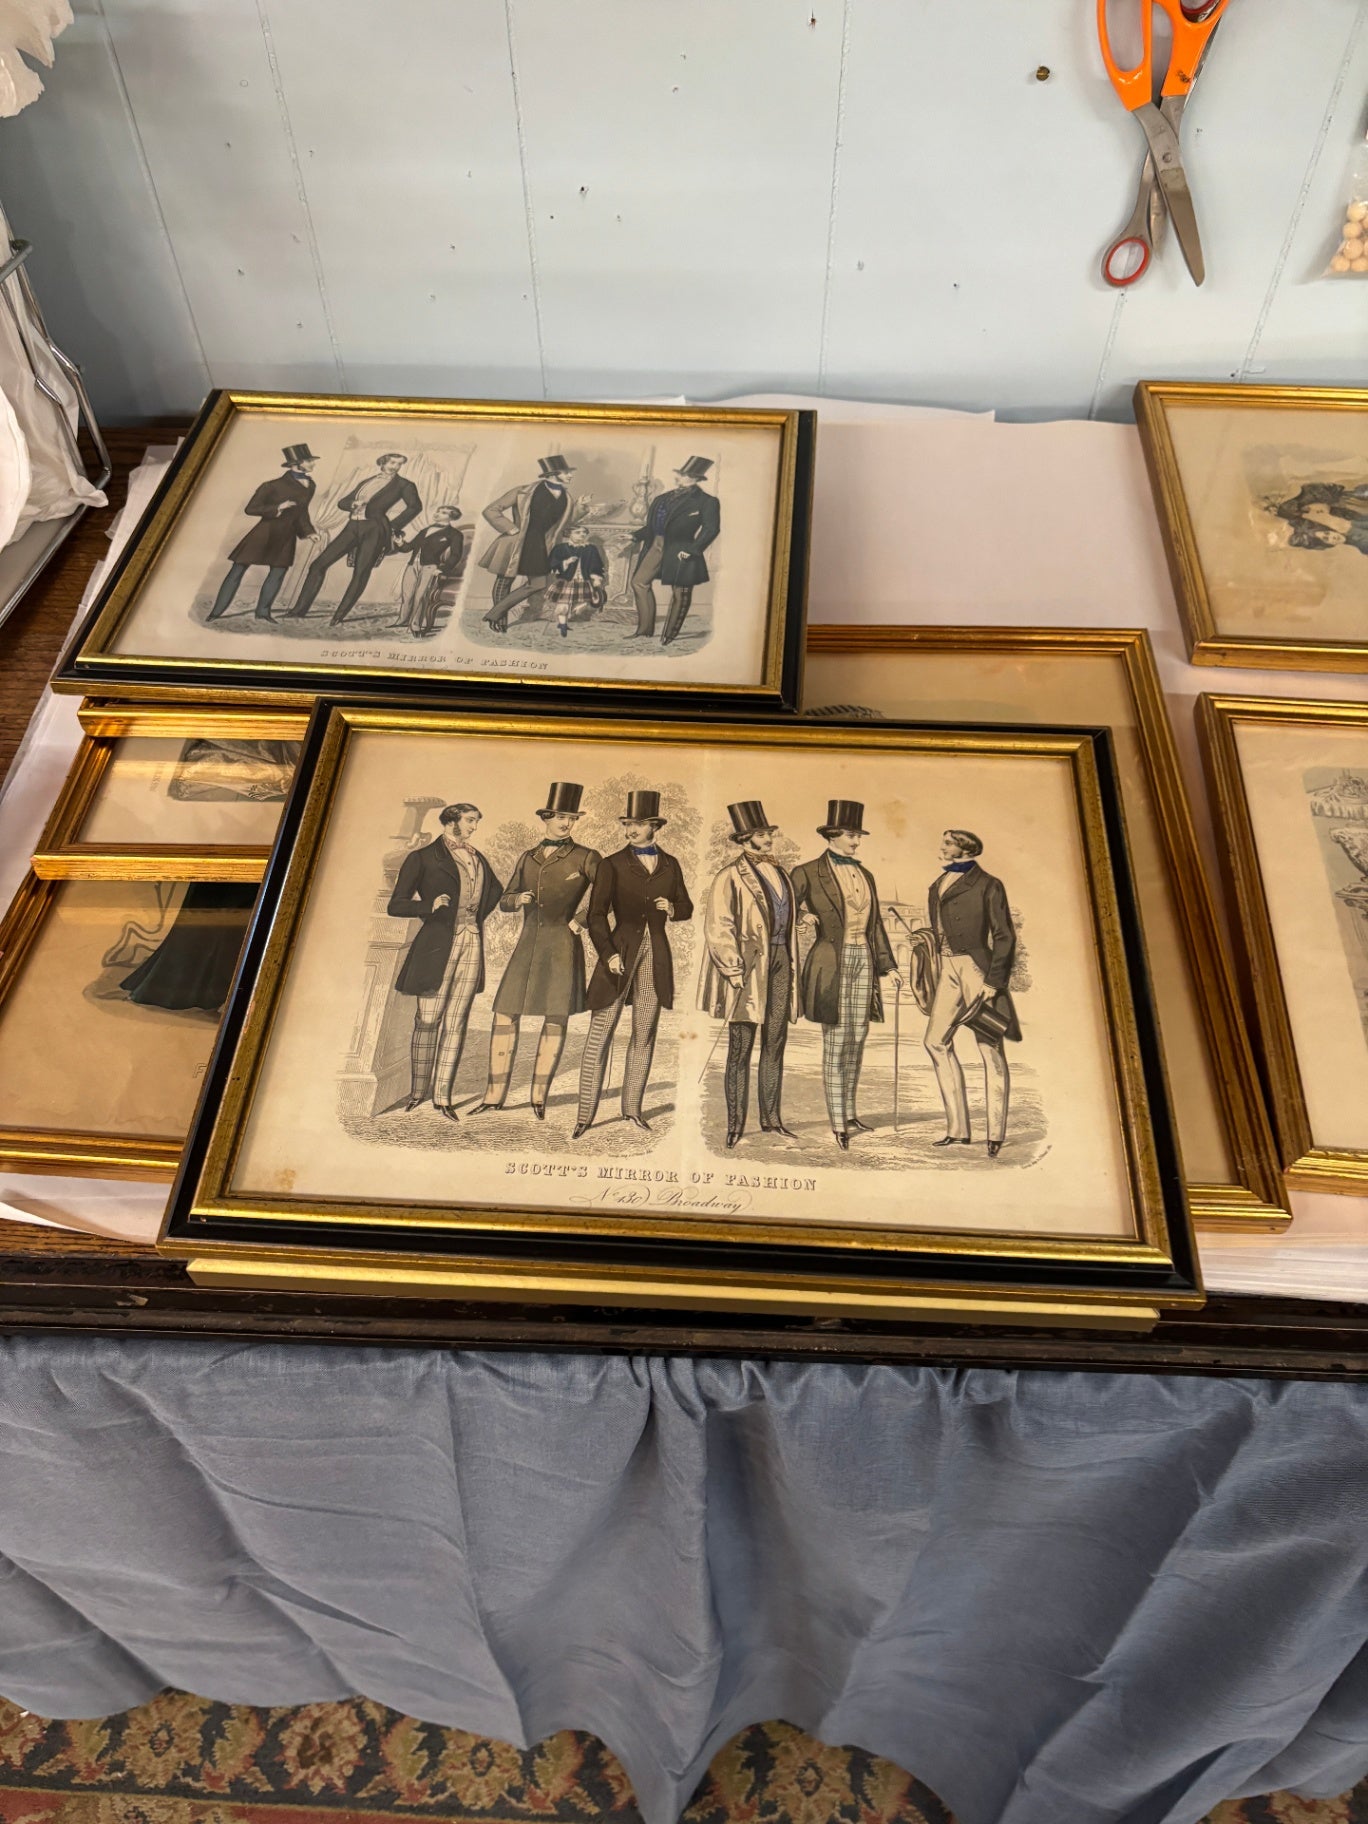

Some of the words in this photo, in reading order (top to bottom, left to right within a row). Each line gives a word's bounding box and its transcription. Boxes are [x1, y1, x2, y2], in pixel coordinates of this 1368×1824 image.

[320, 650, 381, 659] SCOTT'S
[387, 652, 446, 663] MIRROR
[456, 656, 473, 665] OF
[480, 659, 548, 670] FASHION
[504, 1161, 588, 1178] SCOTT'S
[597, 1166, 680, 1183] MIRROR
[690, 1171, 715, 1185] OF
[725, 1174, 817, 1191] FASHION
[649, 1186, 752, 1213] Broadway
